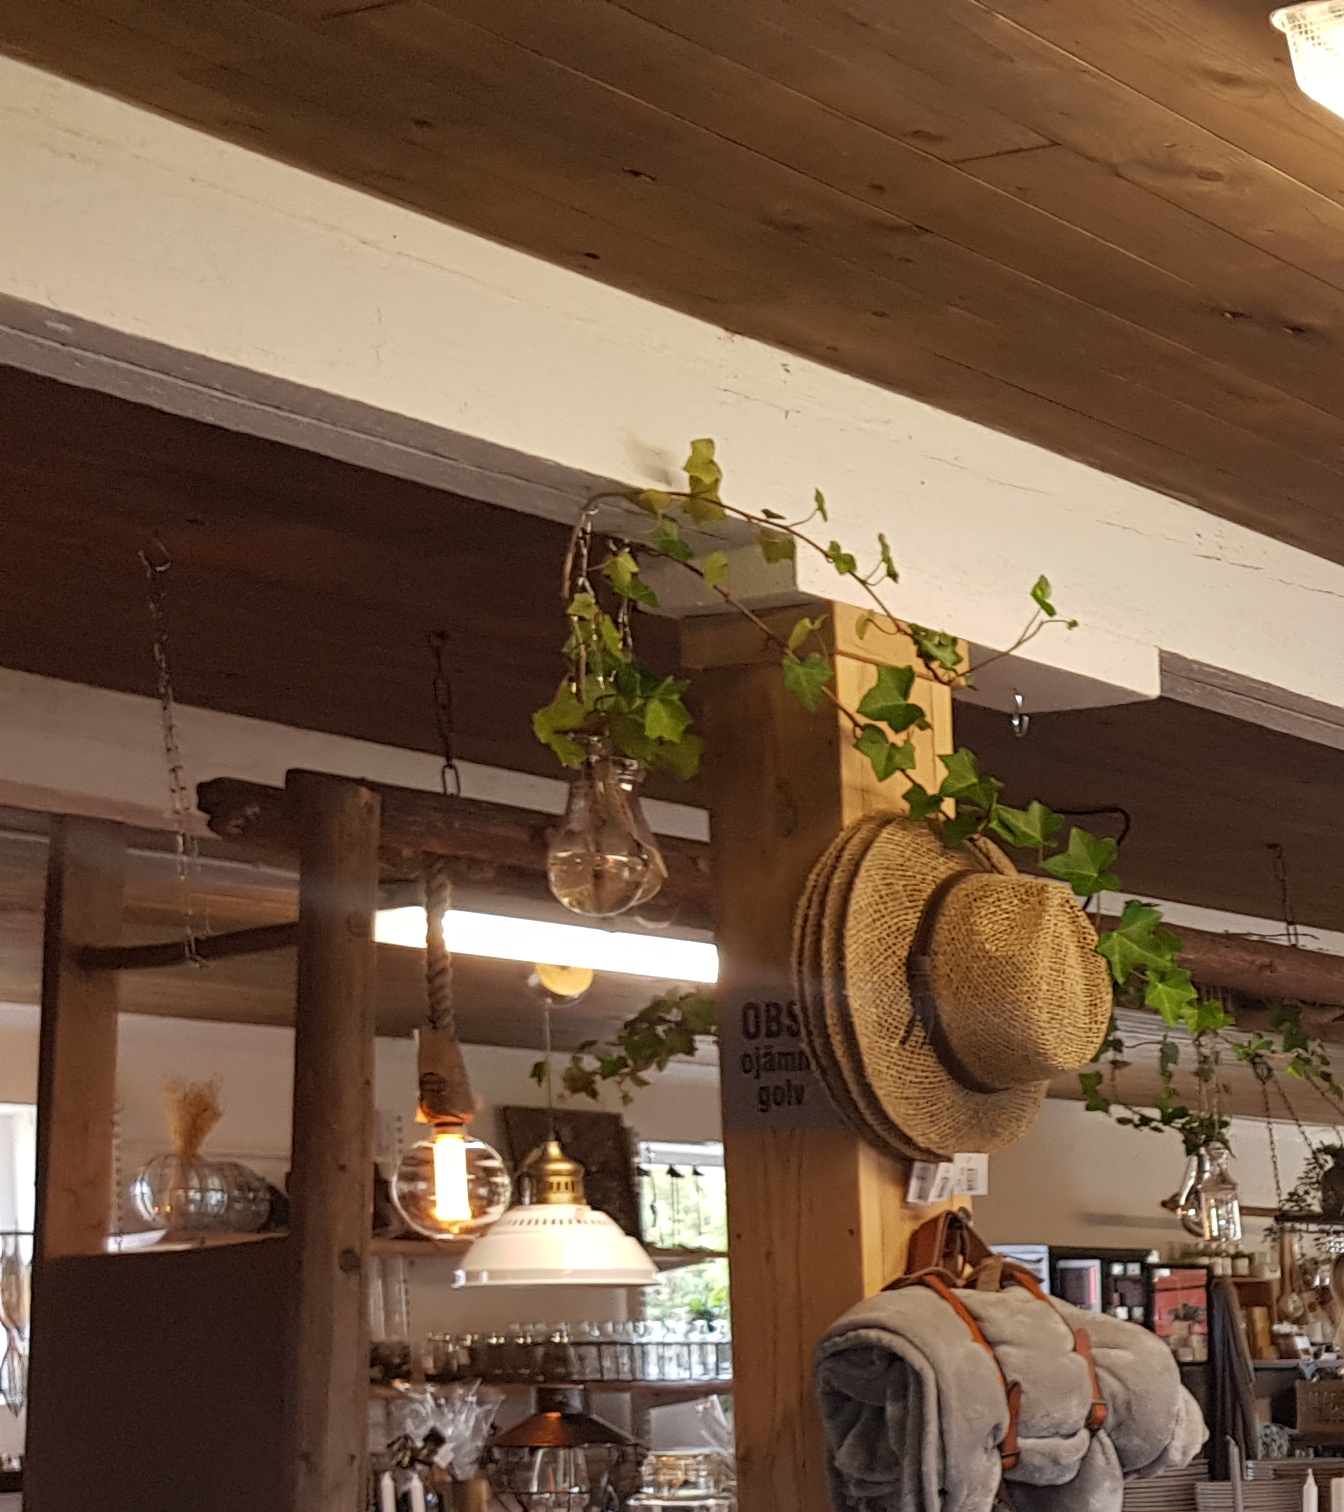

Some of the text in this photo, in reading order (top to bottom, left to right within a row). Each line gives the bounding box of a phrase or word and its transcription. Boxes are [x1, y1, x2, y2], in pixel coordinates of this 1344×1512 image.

[741, 1001, 800, 1040] OBS
[741, 1045, 811, 1079] ojämn
[758, 1079, 806, 1112] golv
